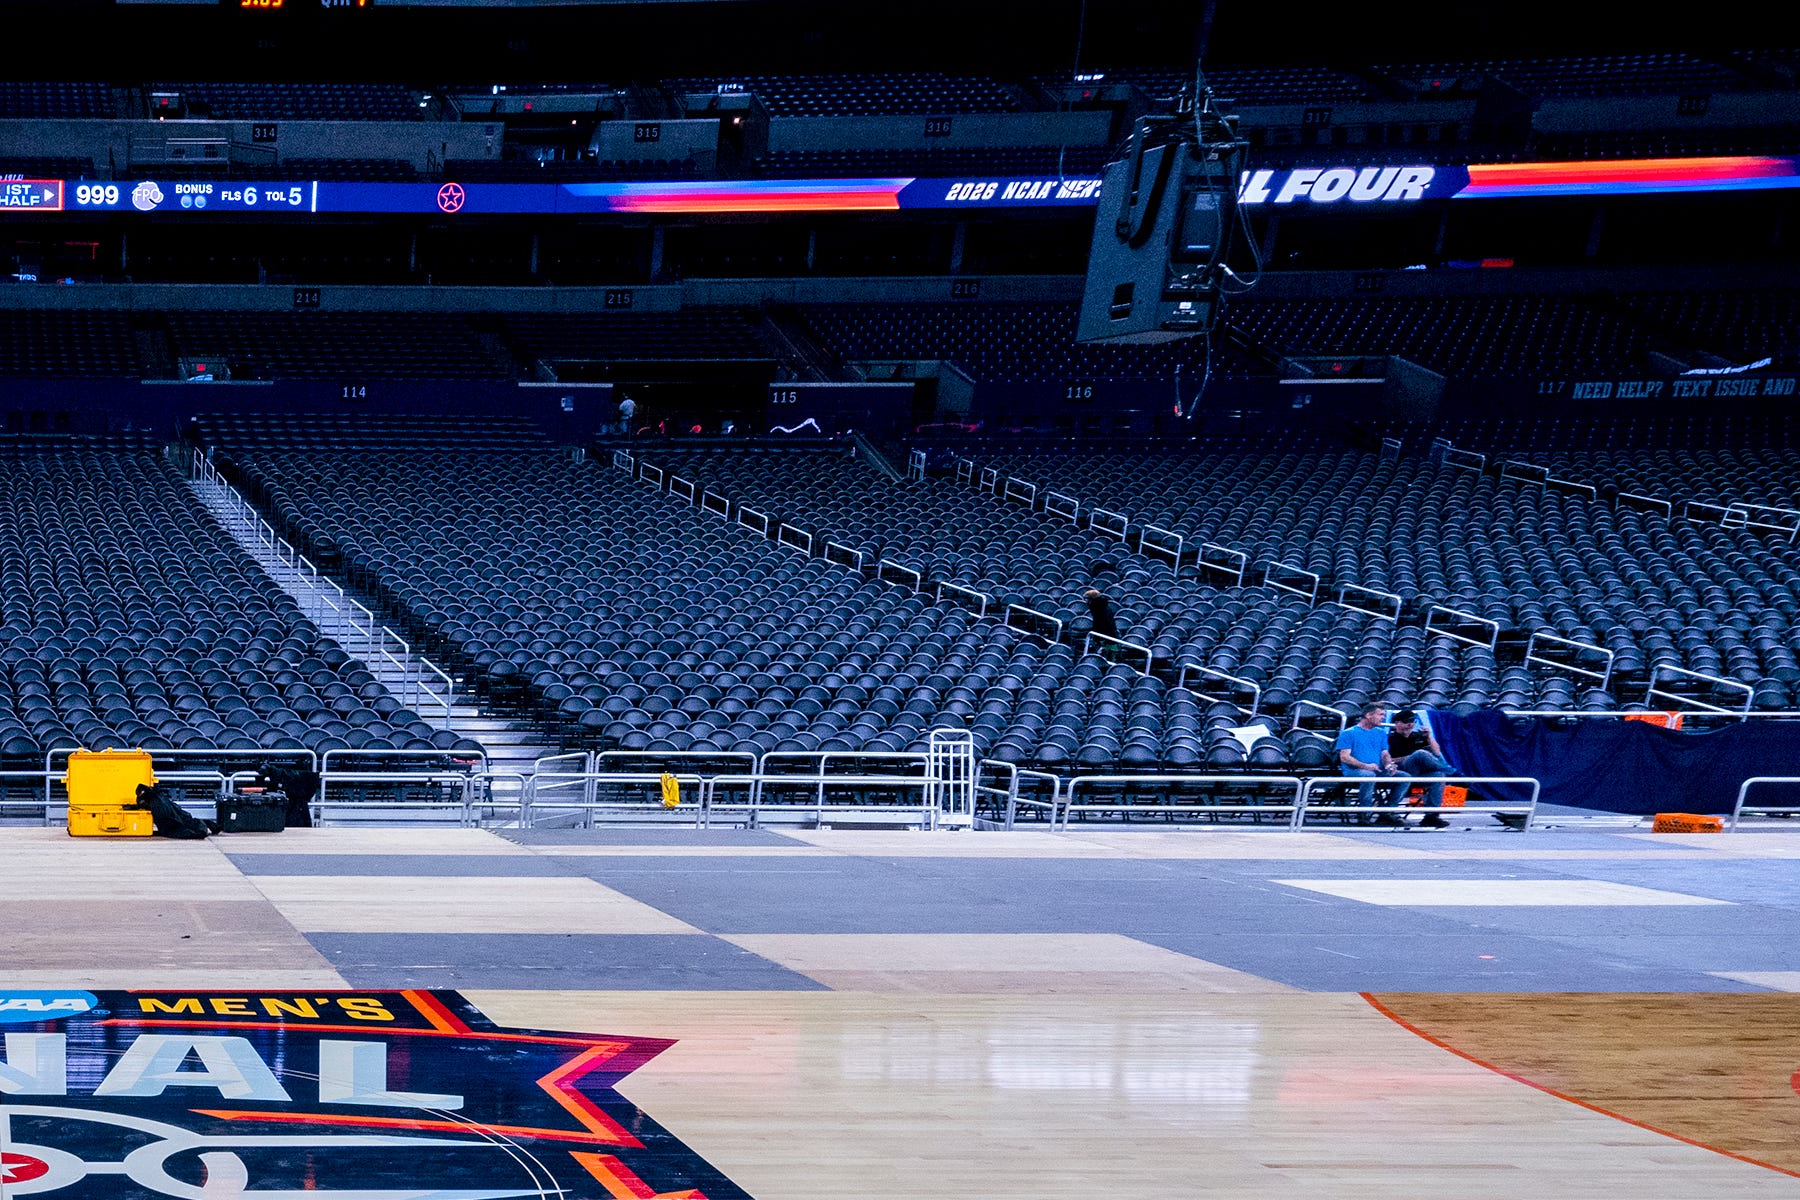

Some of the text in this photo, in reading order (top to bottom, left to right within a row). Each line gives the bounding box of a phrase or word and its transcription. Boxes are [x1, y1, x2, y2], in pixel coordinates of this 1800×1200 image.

[1305, 111, 1329, 123] 317
[254, 127, 276, 139] 314
[635, 127, 659, 139] 315
[926, 120, 950, 133] 316
[175, 183, 213, 194] BONUS
[1274, 166, 1436, 203] FOUR
[76, 185, 119, 205] 999
[221, 186, 258, 205] FLS 6
[265, 187, 302, 206] TOL 5
[944, 182, 999, 201] 2026
[953, 282, 978, 295] 216
[295, 292, 319, 304] 214
[607, 292, 631, 304] 215
[342, 386, 366, 399] 114
[1065, 385, 1092, 399] 116
[1537, 381, 1565, 393] 117
[1572, 378, 1797, 399] NEED HELP? TEXT ISSUE AND
[771, 391, 797, 404] 115
[138, 998, 395, 1021] MEN'S
